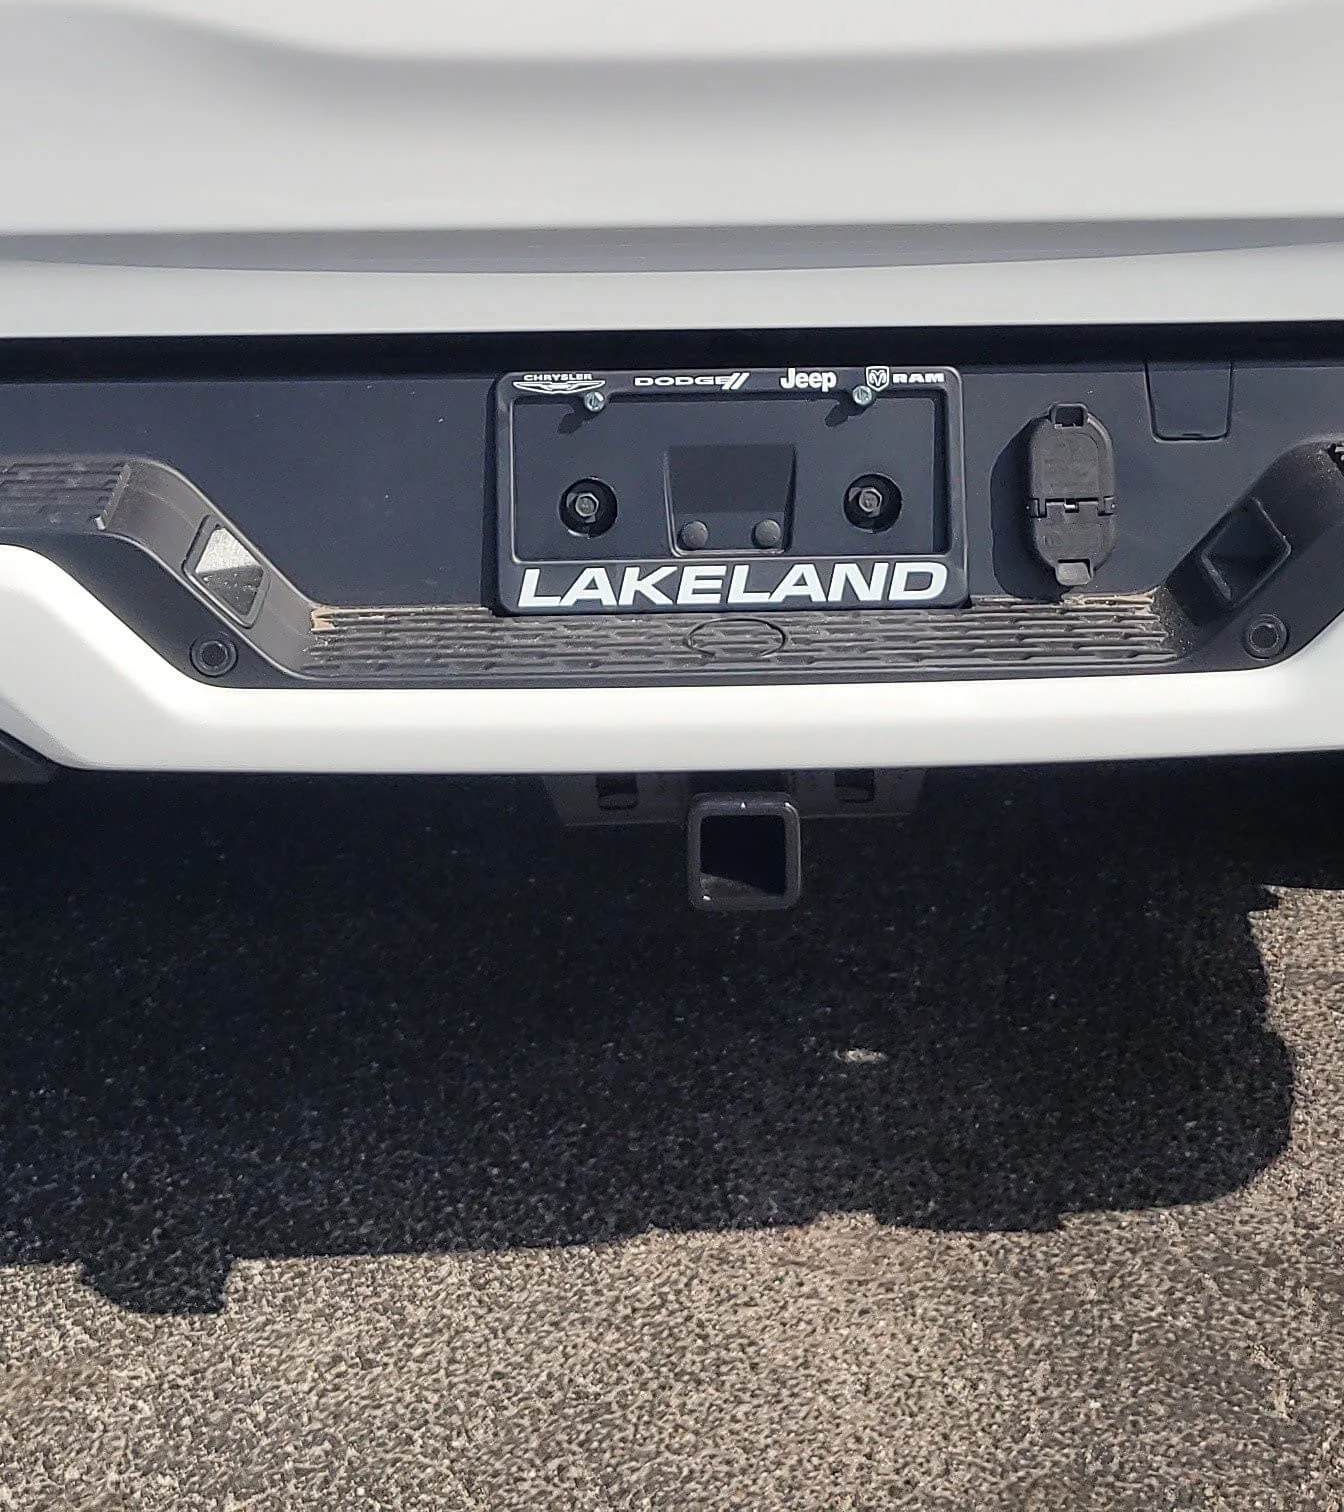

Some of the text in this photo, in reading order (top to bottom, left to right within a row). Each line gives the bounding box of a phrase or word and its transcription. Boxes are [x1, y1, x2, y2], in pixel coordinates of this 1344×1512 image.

[523, 367, 945, 392] CHRYSLER DODGE Jeep RAM
[518, 562, 948, 608] LAKELAND
